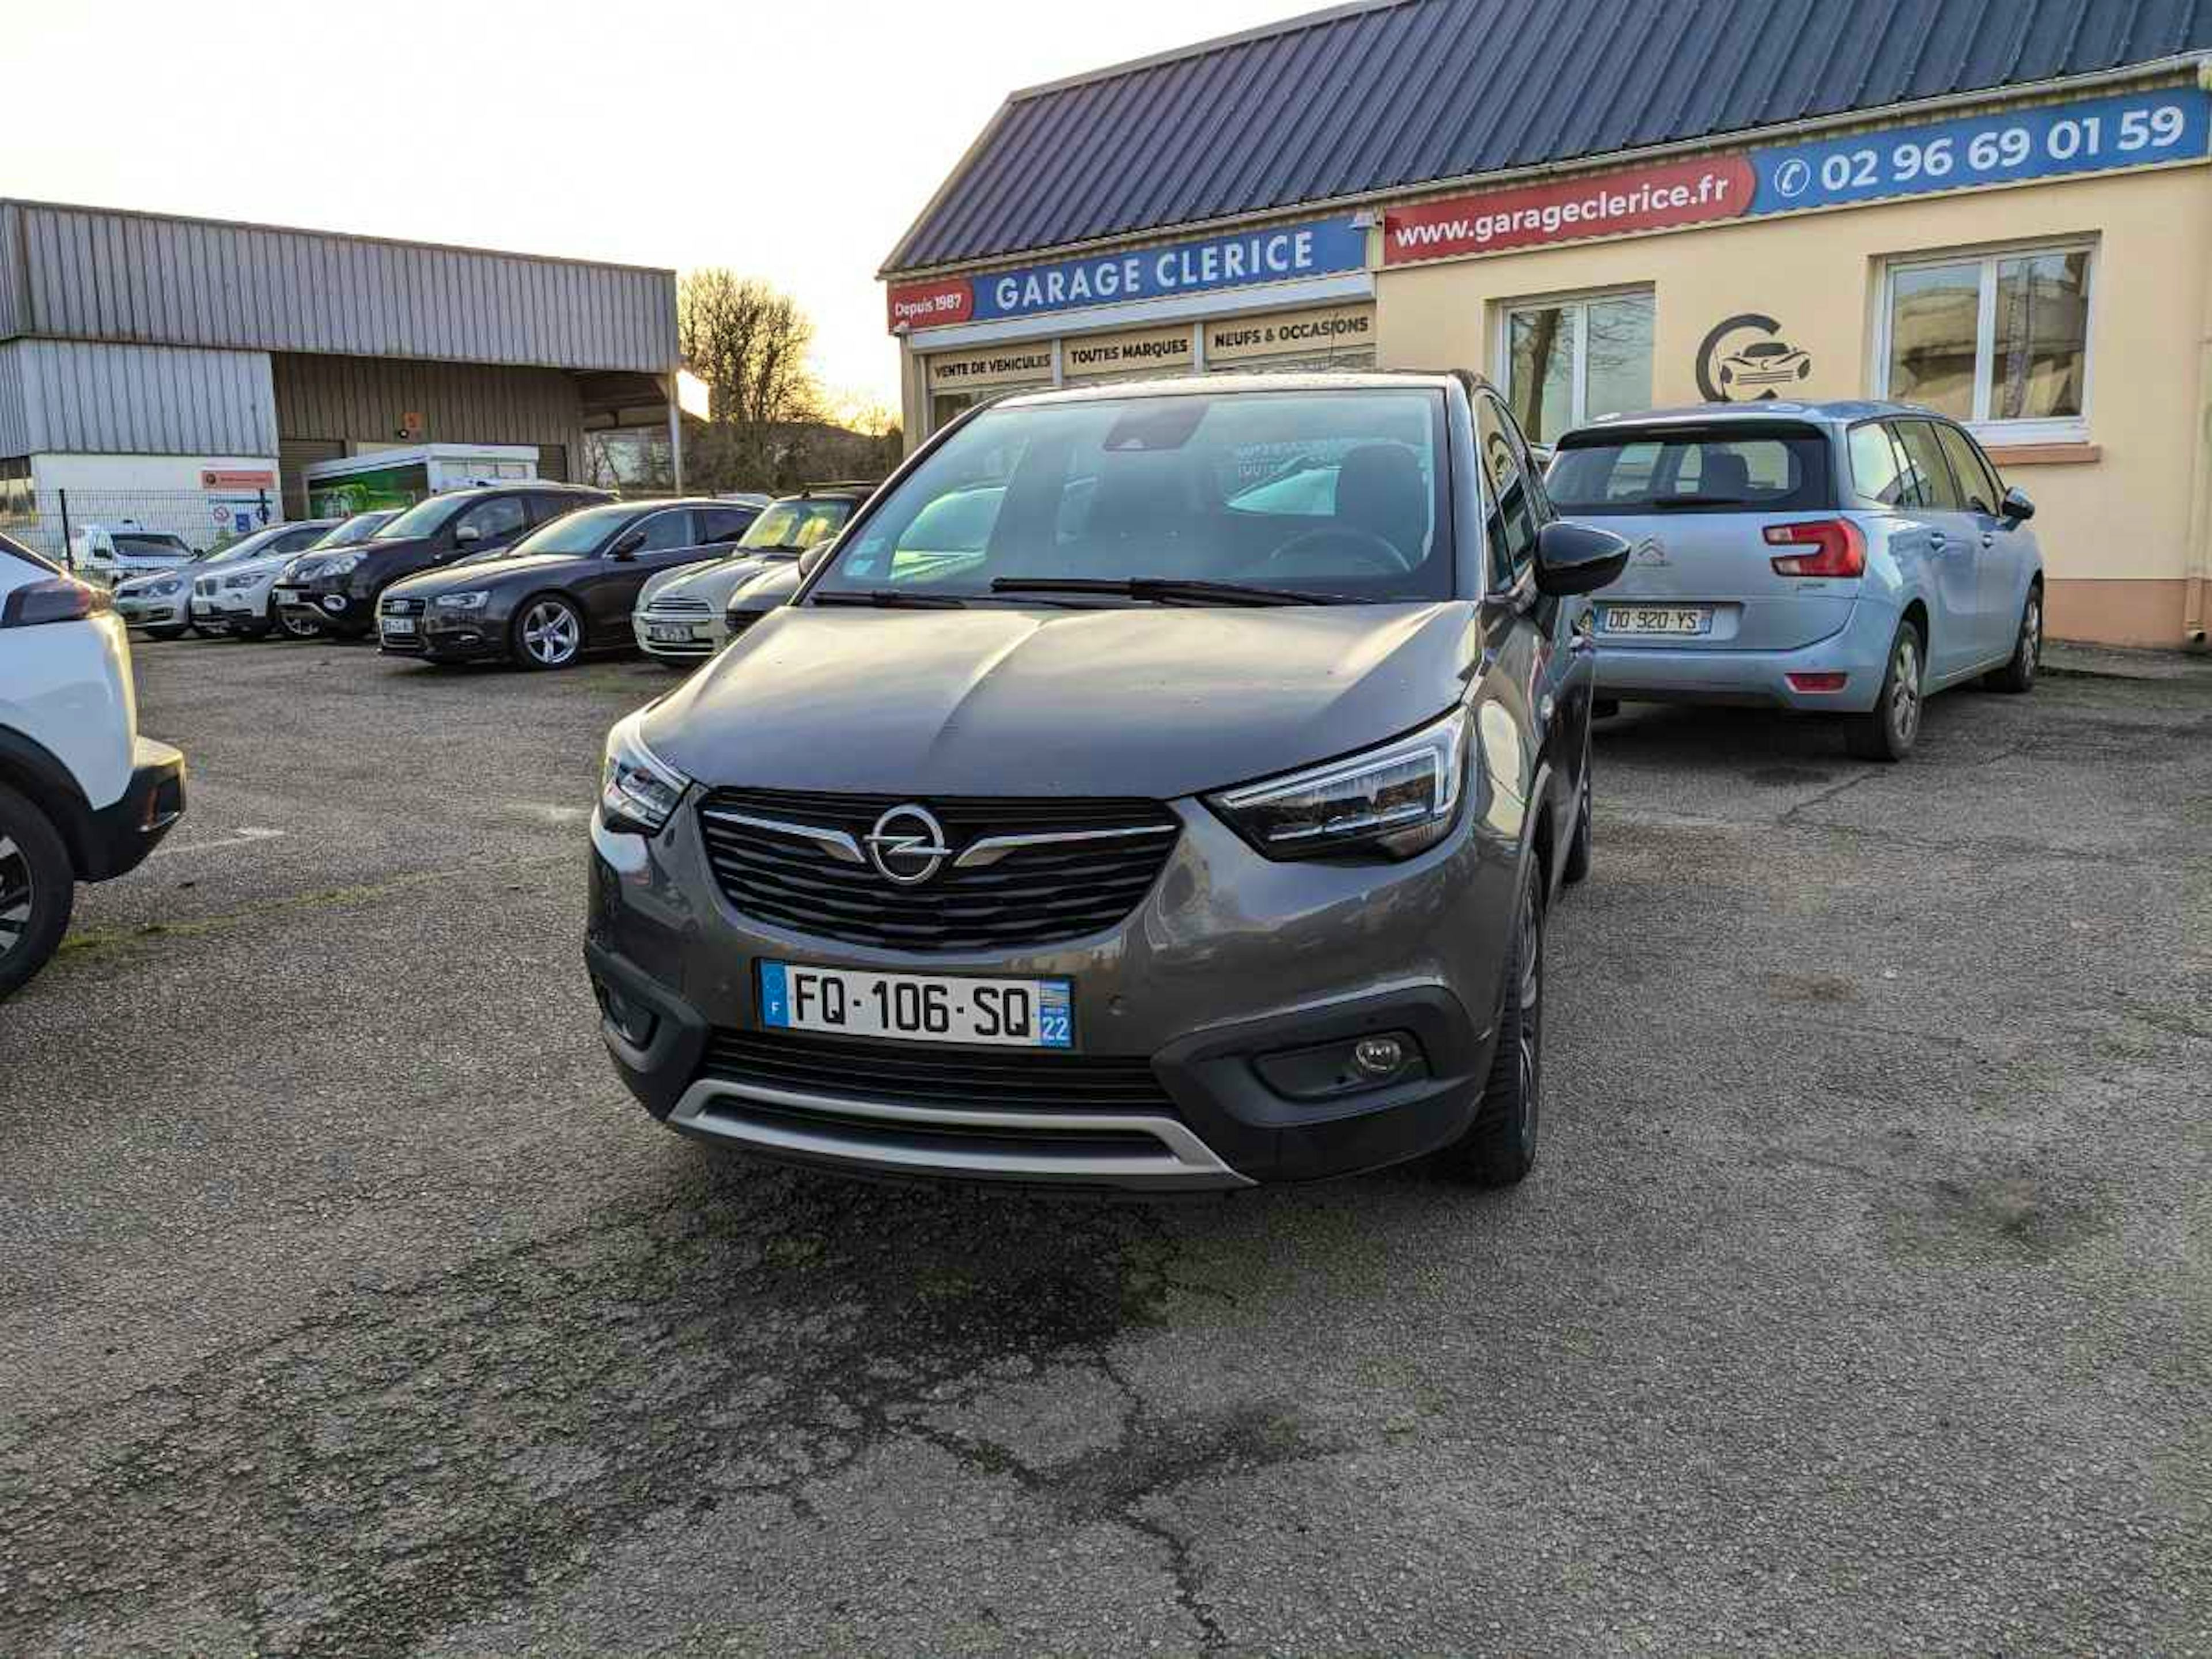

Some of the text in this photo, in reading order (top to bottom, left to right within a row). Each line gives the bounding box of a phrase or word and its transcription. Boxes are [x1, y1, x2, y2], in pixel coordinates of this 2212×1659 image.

[1820, 105, 2185, 191] 02 96 69 01 59
[1395, 174, 1729, 248] www.garageclerice.fr
[995, 231, 1313, 310] GARAGE CLERICE
[895, 293, 962, 320] Depuis 1987
[1214, 316, 1369, 348] NEUFS & OCCASIONS
[1071, 339, 1188, 364] TOUTES MARQUES
[934, 353, 1051, 378] VENTE DE VEHICULES
[771, 1002, 781, 1015] F
[1043, 1016, 1070, 1041] 22
